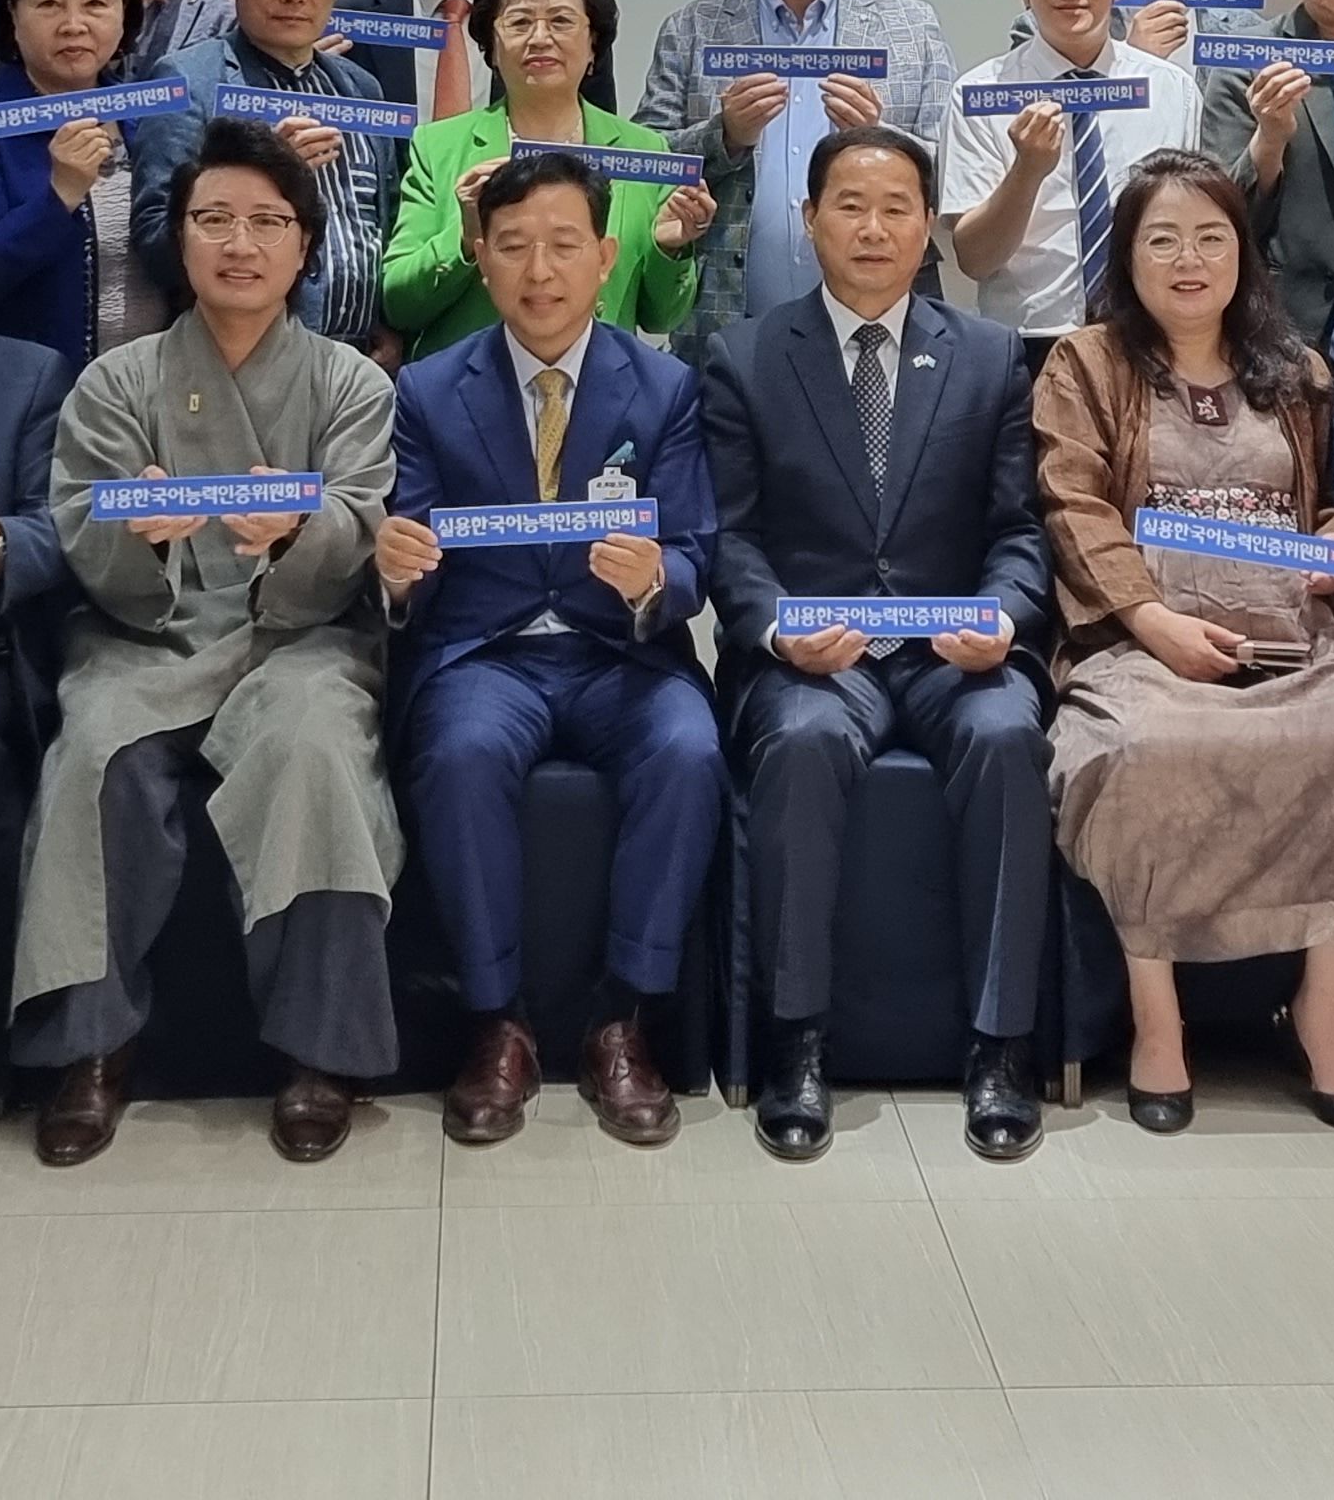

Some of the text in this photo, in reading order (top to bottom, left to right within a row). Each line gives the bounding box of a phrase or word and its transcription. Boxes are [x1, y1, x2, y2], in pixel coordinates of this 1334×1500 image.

[709, 53, 871, 71] 실용한국어능력인증위원회
[221, 91, 398, 127] 실용한국어능력인증위원회
[967, 84, 1133, 108] 실용한국어능력인증위원회
[98, 481, 302, 510] 실용한국어능력인증위원회
[437, 508, 637, 539] 실용한국어능력인증위원회
[1142, 515, 1329, 564] 실용한국어능력인증위원회
[784, 606, 979, 627] 실용한국어능력인증위원회
